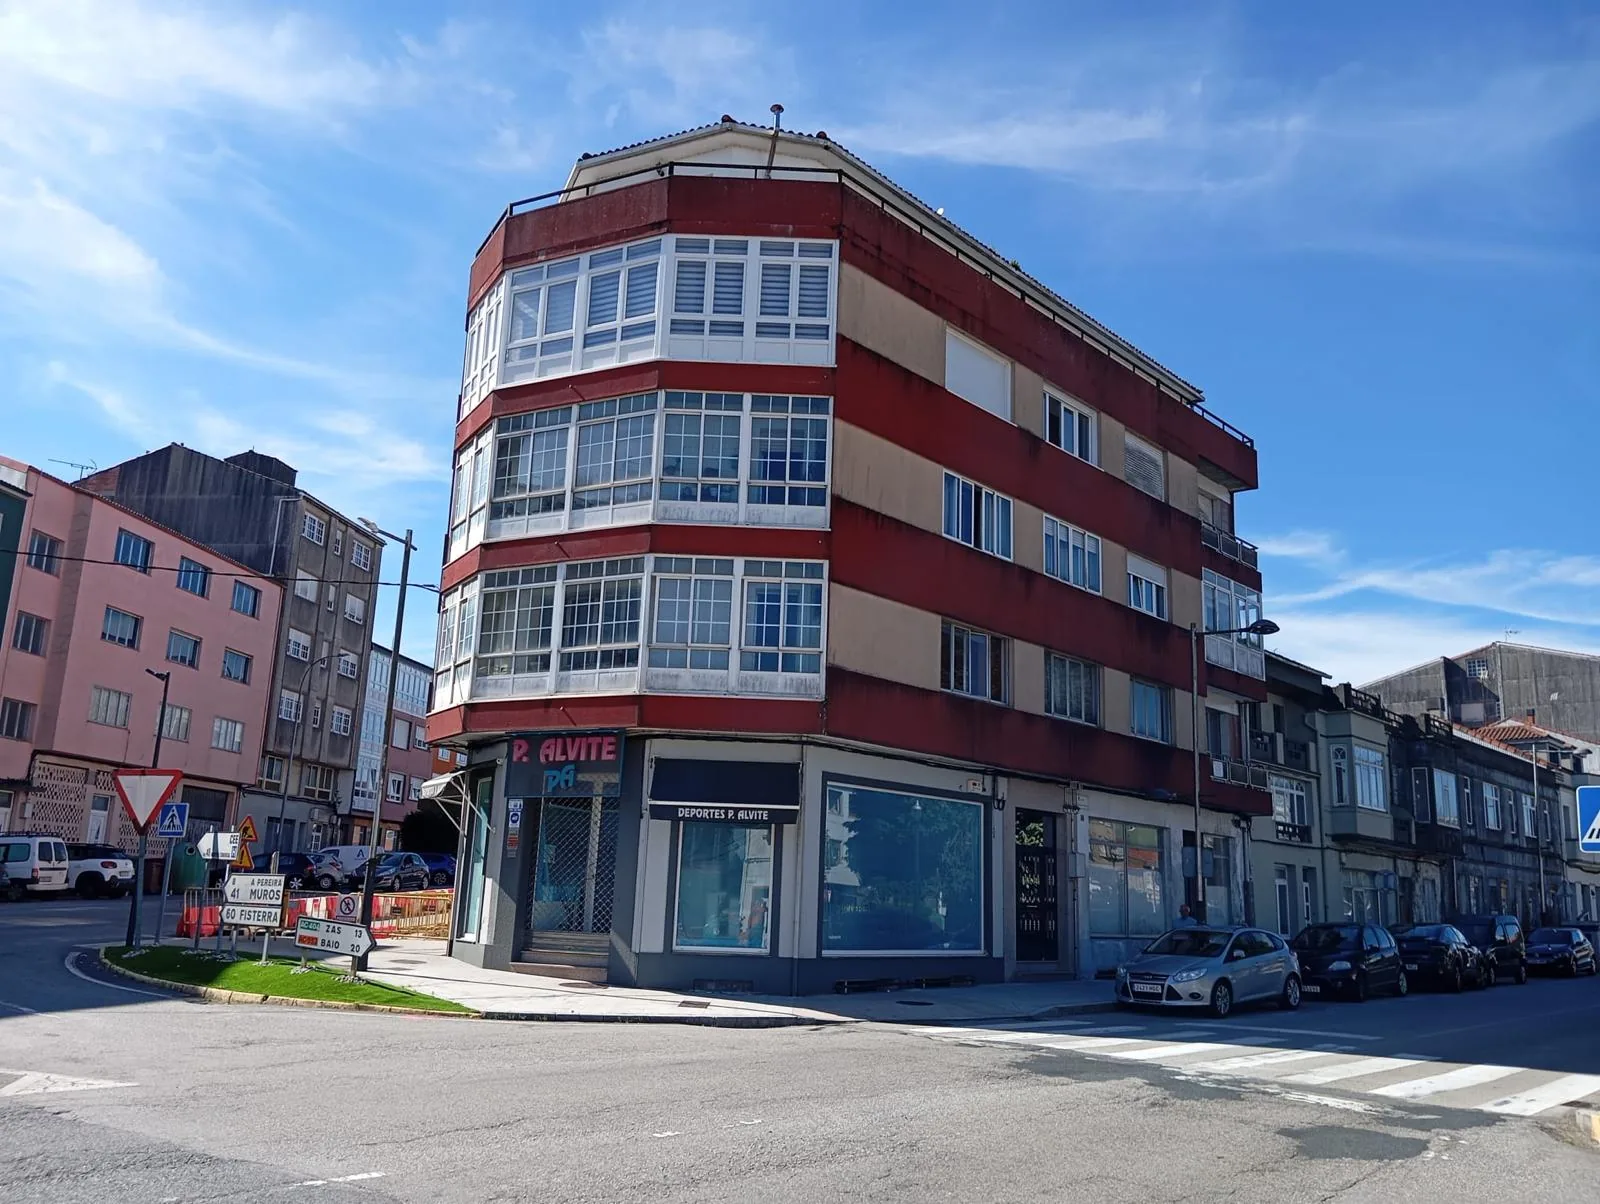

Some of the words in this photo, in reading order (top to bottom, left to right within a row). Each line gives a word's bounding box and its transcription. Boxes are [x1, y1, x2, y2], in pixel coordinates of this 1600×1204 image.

[512, 739, 529, 762] P.
[539, 736, 617, 763] ALVITE
[678, 807, 726, 819] DEPORTES
[728, 809, 735, 820] P.
[737, 809, 769, 821] ALVITE
[230, 834, 239, 844] CEE
[251, 878, 255, 886] A
[257, 878, 282, 887] PEREIRA
[230, 887, 240, 899] 41
[249, 888, 281, 901] MUROS
[226, 908, 236, 919] 60
[239, 909, 278, 923] FISTERRA
[325, 925, 342, 934] ZAS
[355, 929, 363, 938] 13
[320, 938, 340, 949] BAIO
[350, 944, 361, 953] 20
